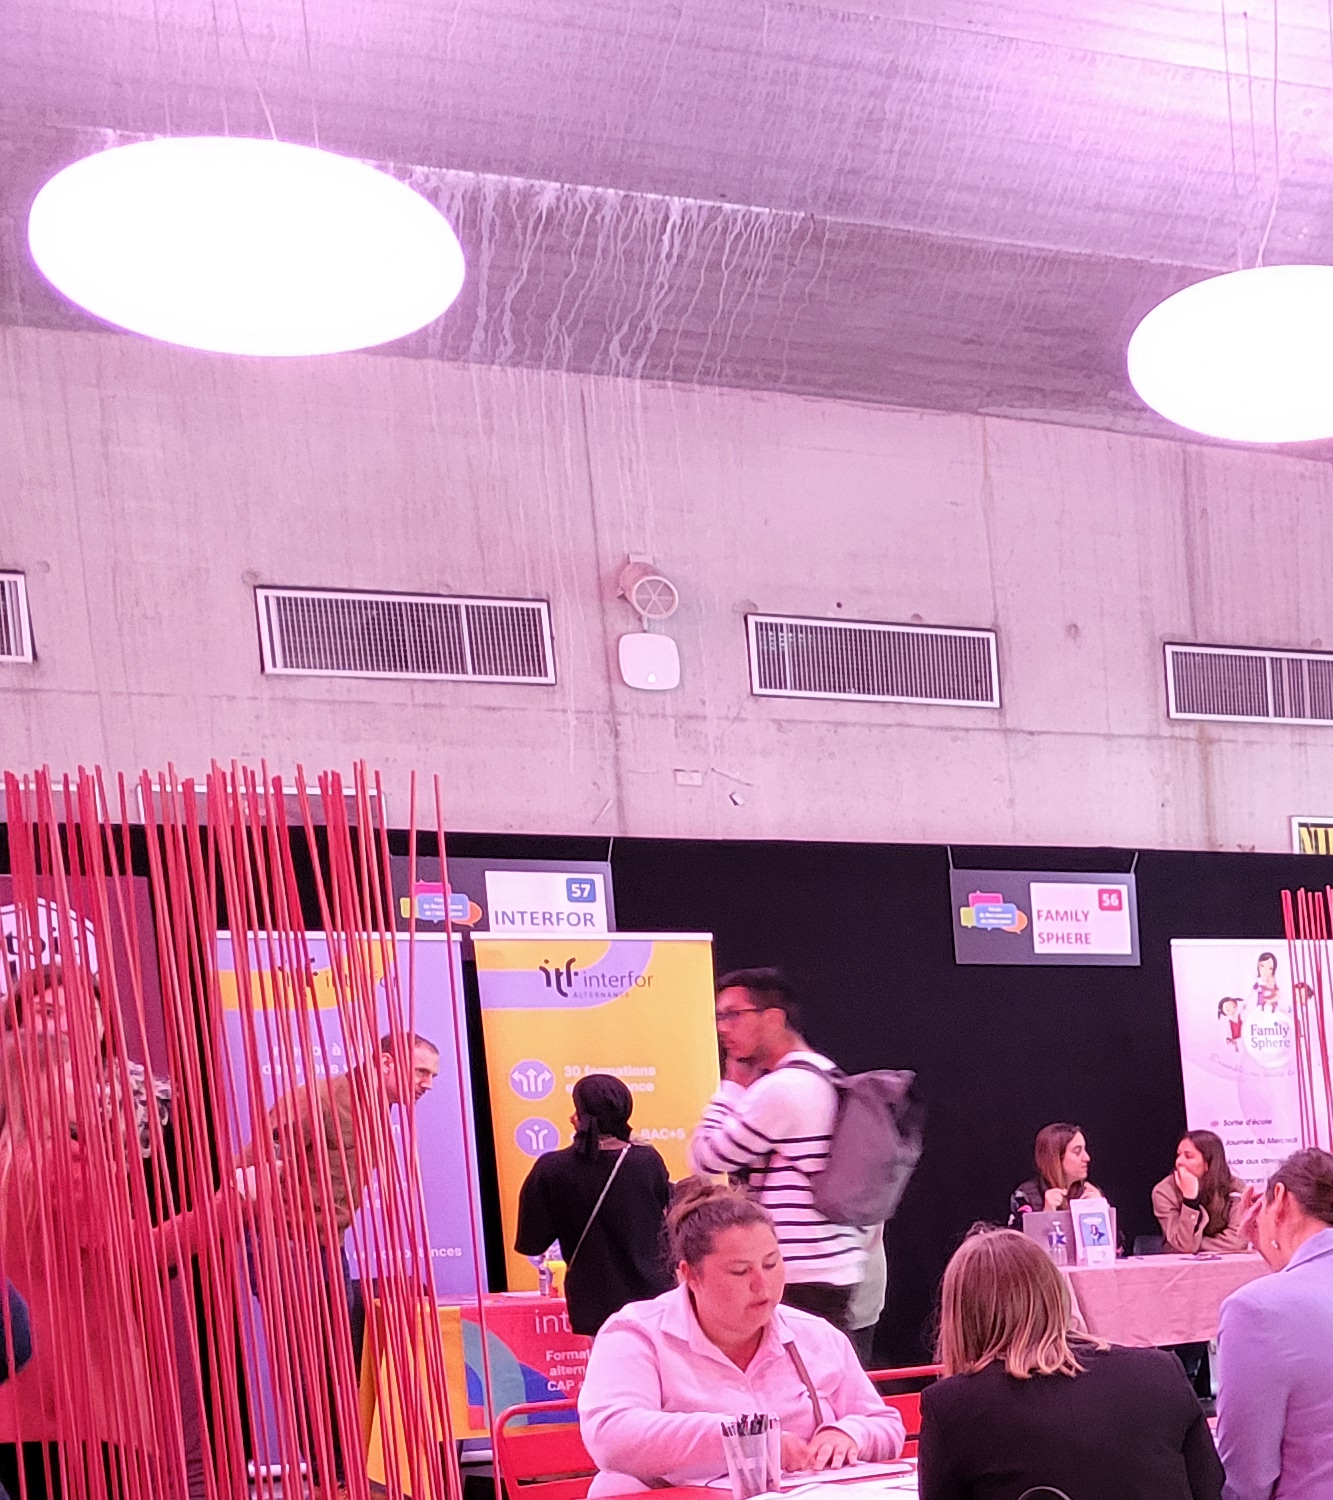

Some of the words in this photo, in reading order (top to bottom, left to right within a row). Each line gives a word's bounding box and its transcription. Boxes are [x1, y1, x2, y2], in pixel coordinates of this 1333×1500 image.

[570, 882, 592, 898] 57
[1101, 893, 1120, 907] 56
[494, 910, 597, 927] INTERFOR
[1036, 909, 1090, 923] FAMILY
[1037, 932, 1092, 945] SPHERE
[583, 970, 654, 988] interfor
[1250, 1021, 1290, 1037] Family
[1251, 1038, 1291, 1050] Sphere
[563, 1065, 581, 1077] 30
[547, 1379, 575, 1392] CAP
